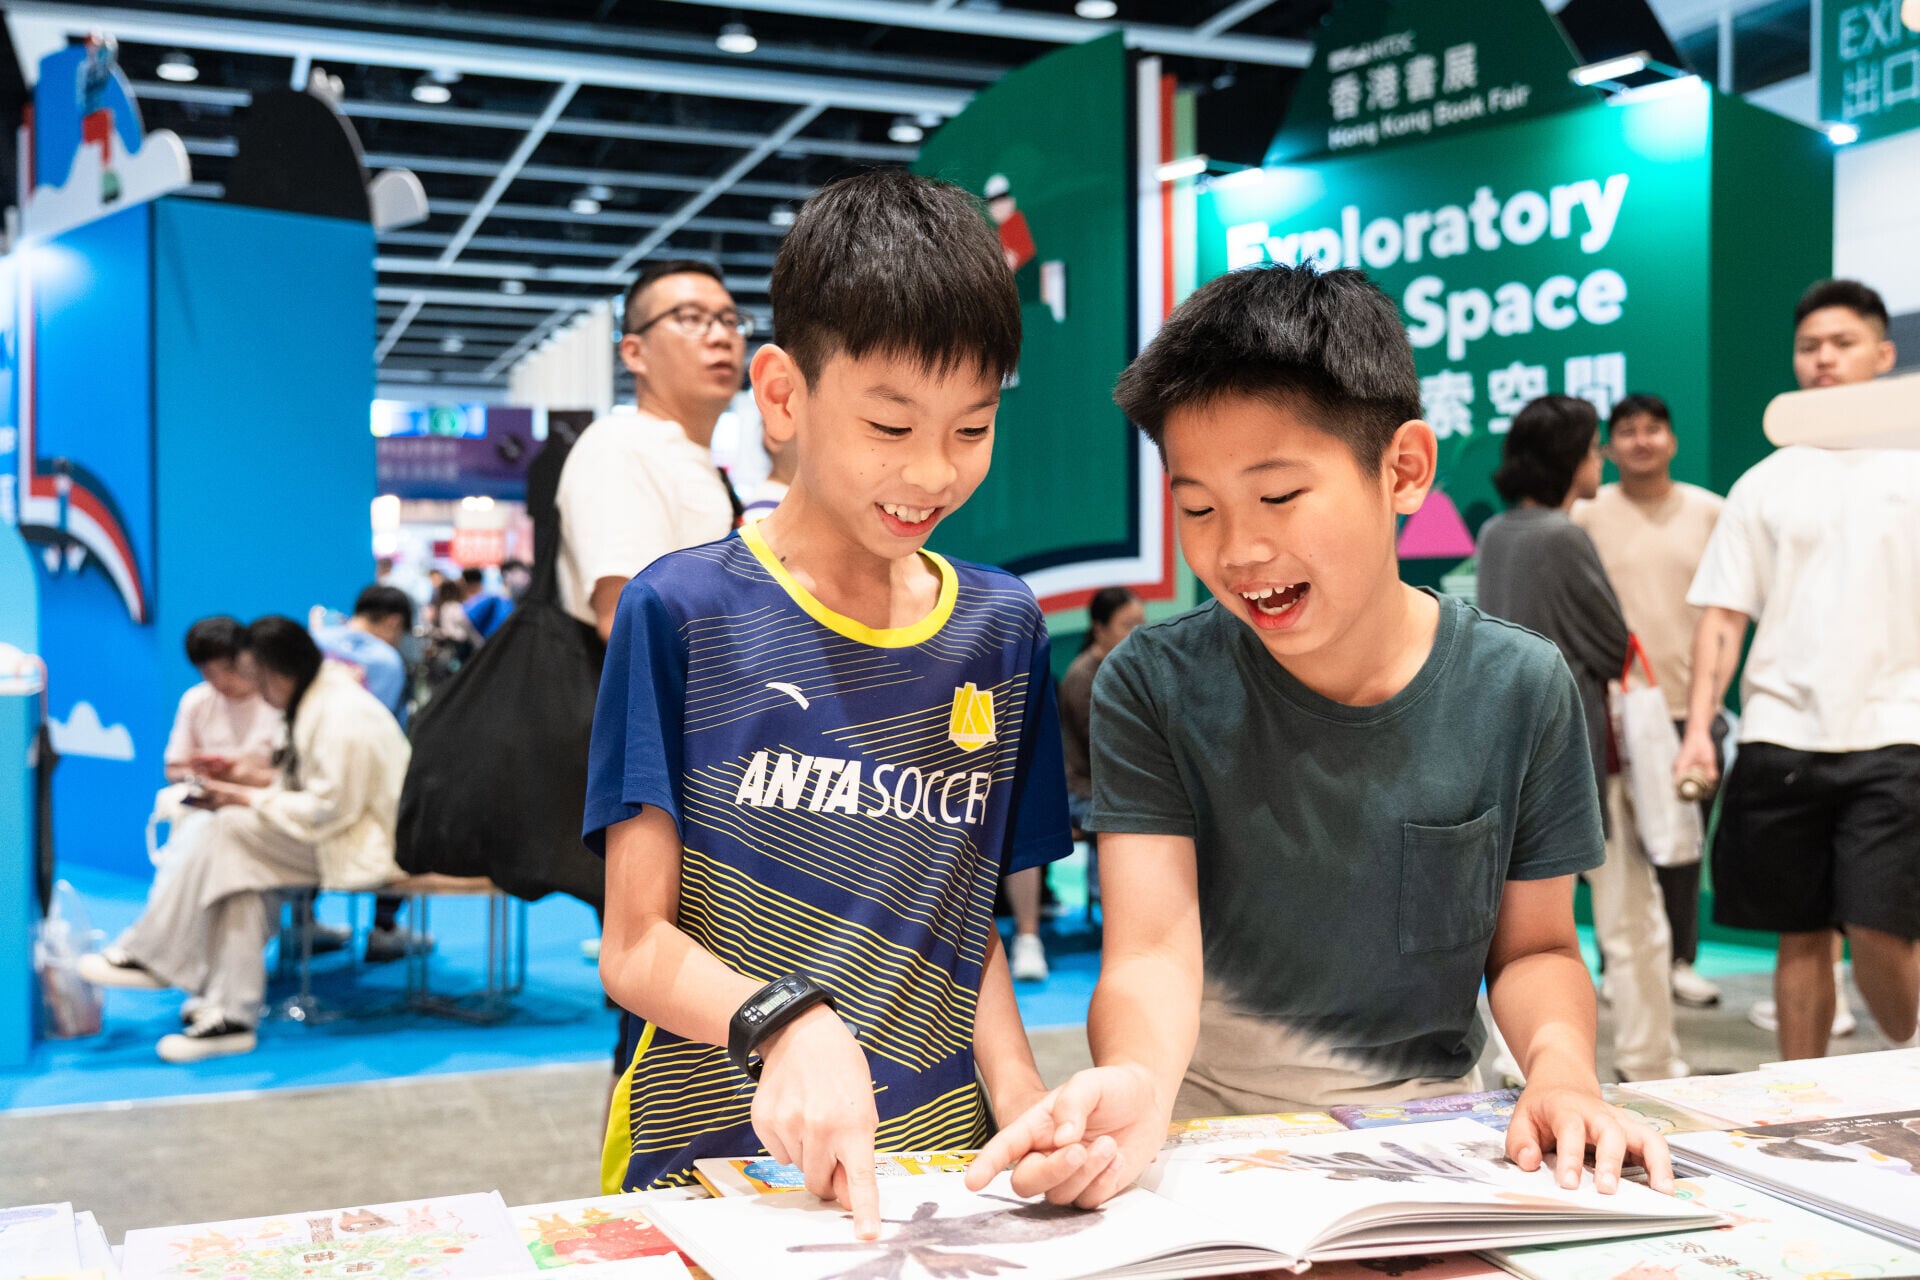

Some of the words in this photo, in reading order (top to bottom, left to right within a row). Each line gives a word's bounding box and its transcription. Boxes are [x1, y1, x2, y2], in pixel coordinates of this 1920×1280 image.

[1839, 0, 1918, 60] EXI
[1328, 121, 1379, 150] Hong
[1380, 109, 1432, 138] Kong
[1433, 94, 1485, 127] Book
[1487, 83, 1532, 113] Fair
[1330, 43, 1477, 121] 香港書展
[1841, 49, 1920, 120] 出口
[1226, 173, 1629, 272] Exploratory
[1404, 269, 1628, 361] Space
[735, 751, 862, 814] ANTA
